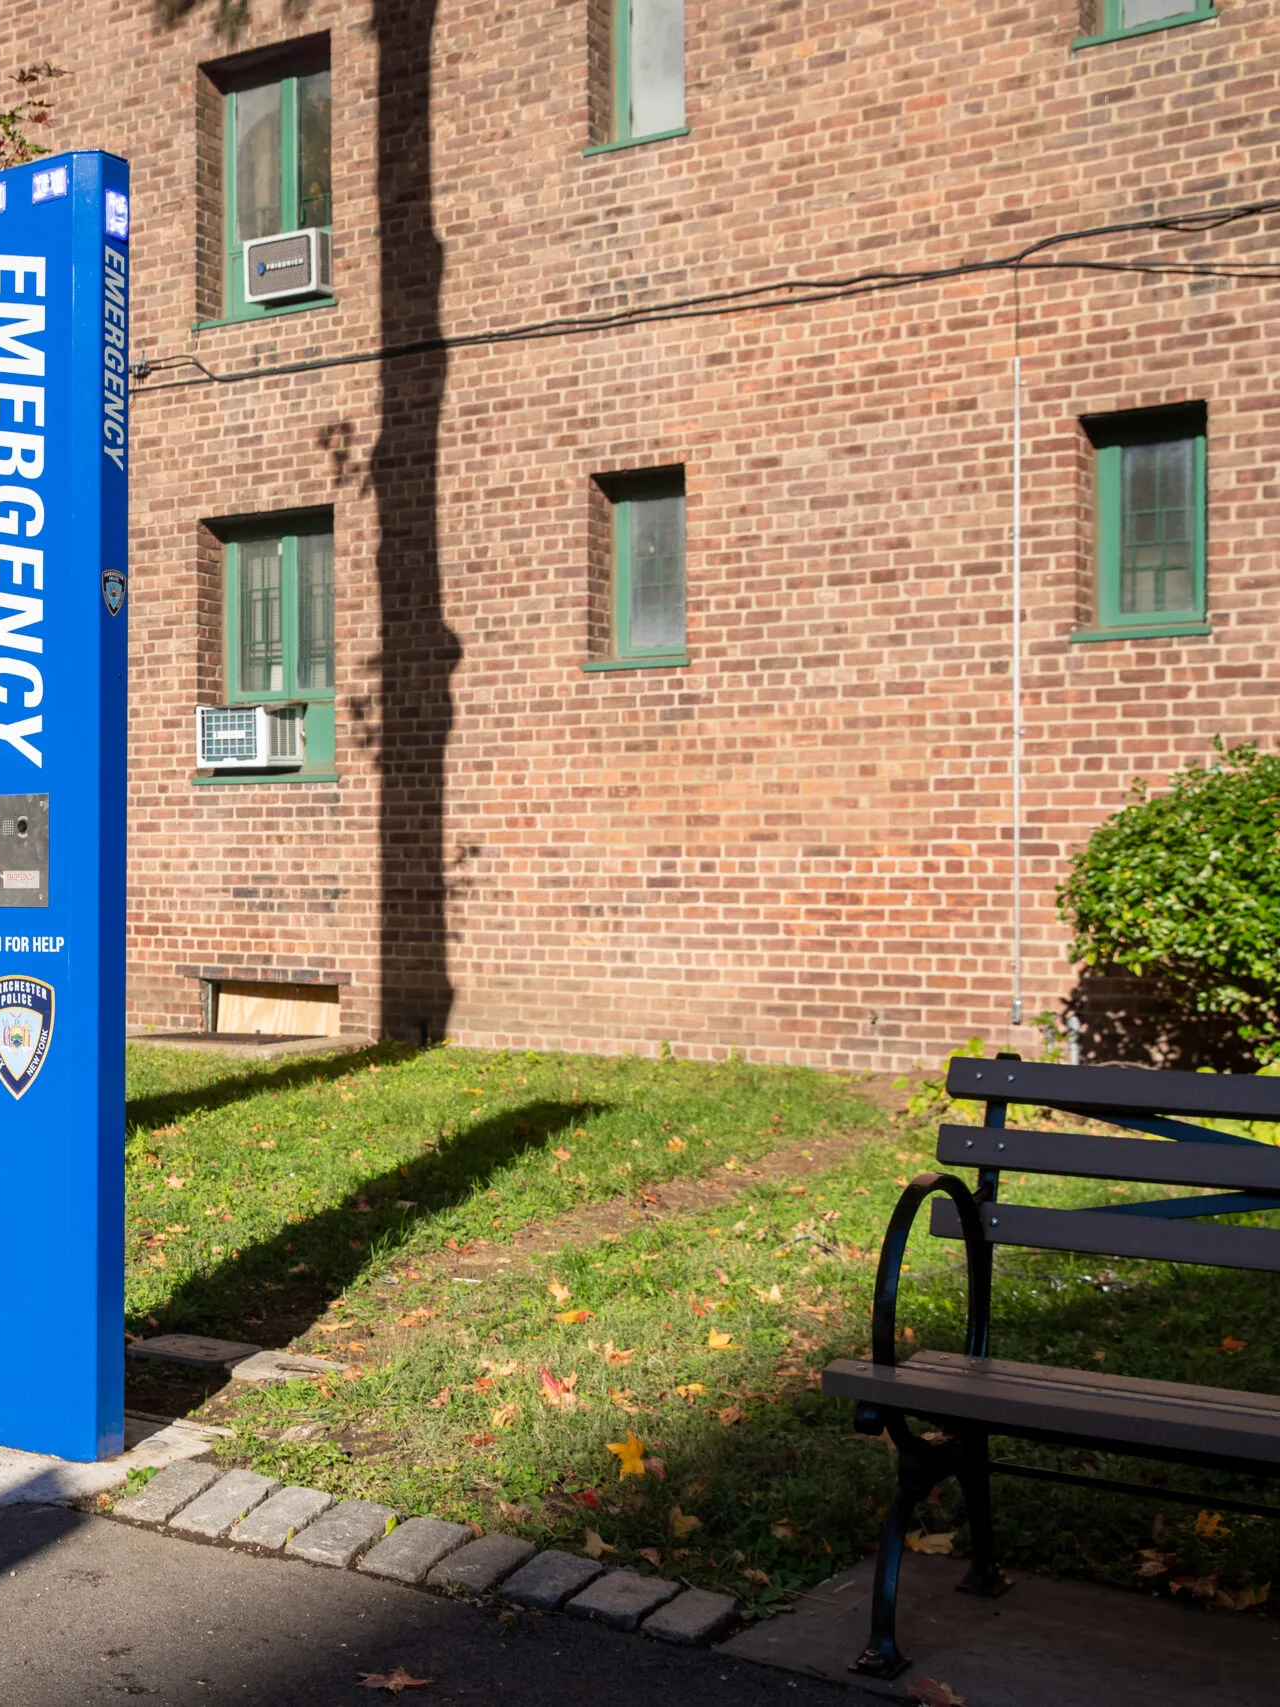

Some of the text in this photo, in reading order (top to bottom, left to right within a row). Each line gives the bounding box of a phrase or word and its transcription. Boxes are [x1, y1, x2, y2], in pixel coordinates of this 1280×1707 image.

[104, 245, 125, 471] EMERGENCY
[5, 936, 30, 952] FOR
[32, 936, 65, 952] HELP
[1, 994, 33, 1007] POLICE
[26, 1029, 49, 1077] NEW YORK
